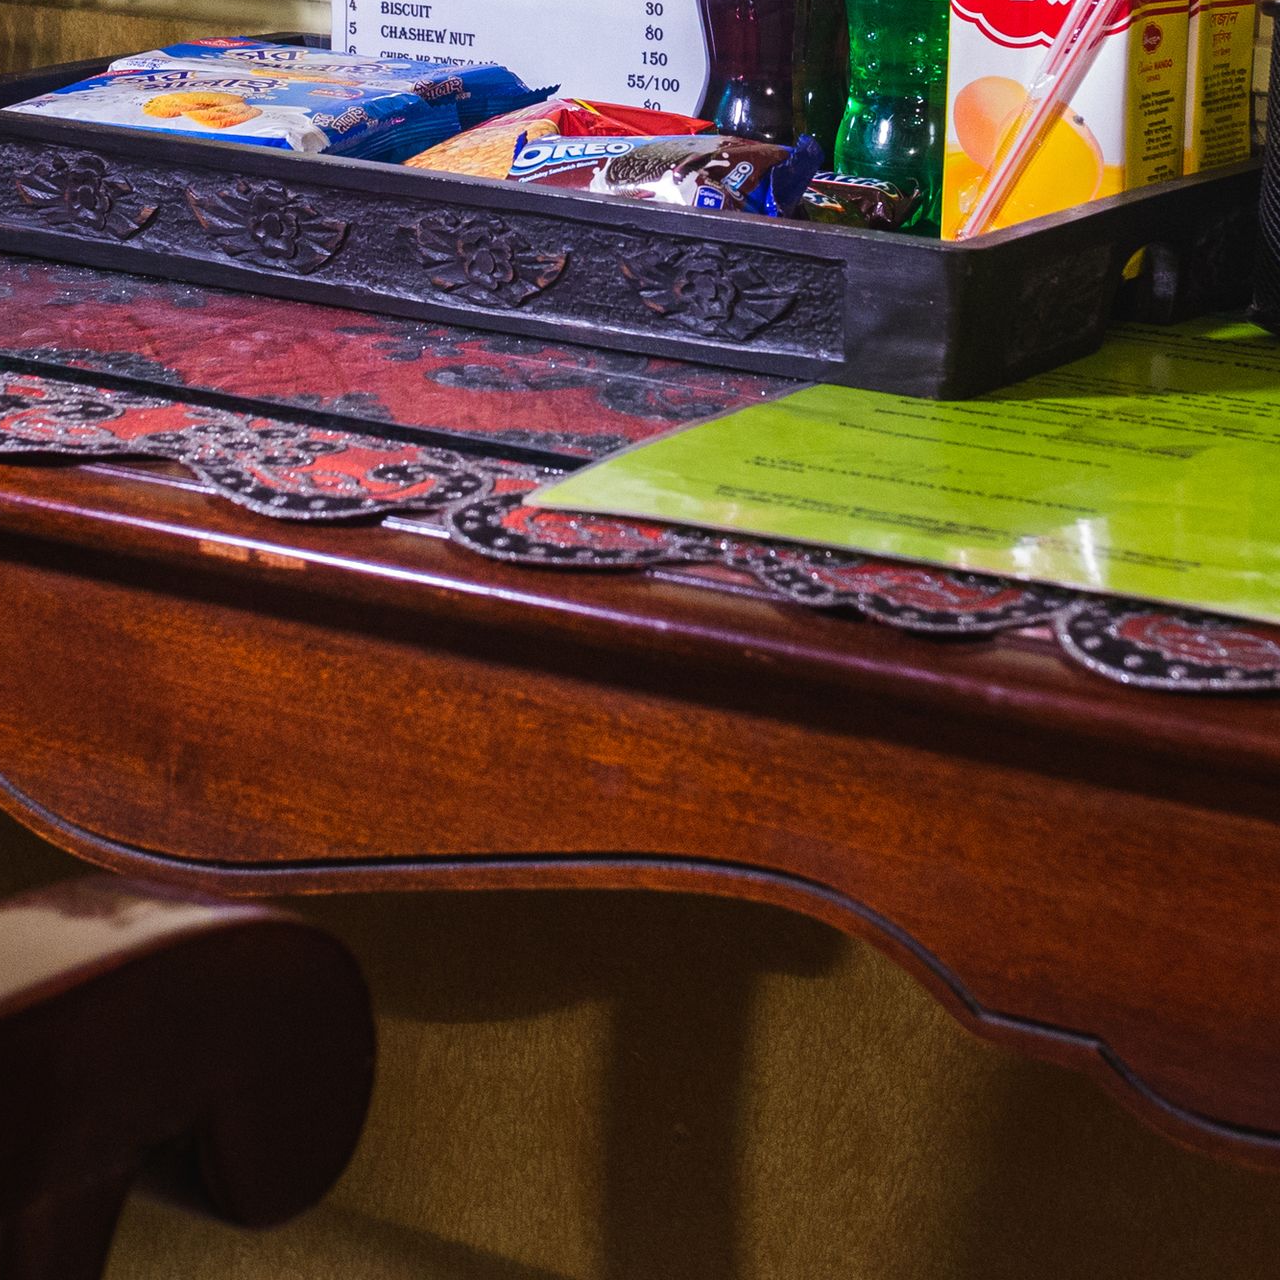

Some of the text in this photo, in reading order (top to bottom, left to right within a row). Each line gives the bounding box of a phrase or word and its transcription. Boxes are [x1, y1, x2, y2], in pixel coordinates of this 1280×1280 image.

[645, 1, 664, 16] 30
[381, 1, 432, 19] BISCUIT
[645, 24, 664, 41] 80
[349, 22, 668, 67] 5 CHASHEW NUT 150
[627, 74, 680, 93] 55/100
[516, 142, 633, 170] OREO
[703, 197, 715, 206] 96
